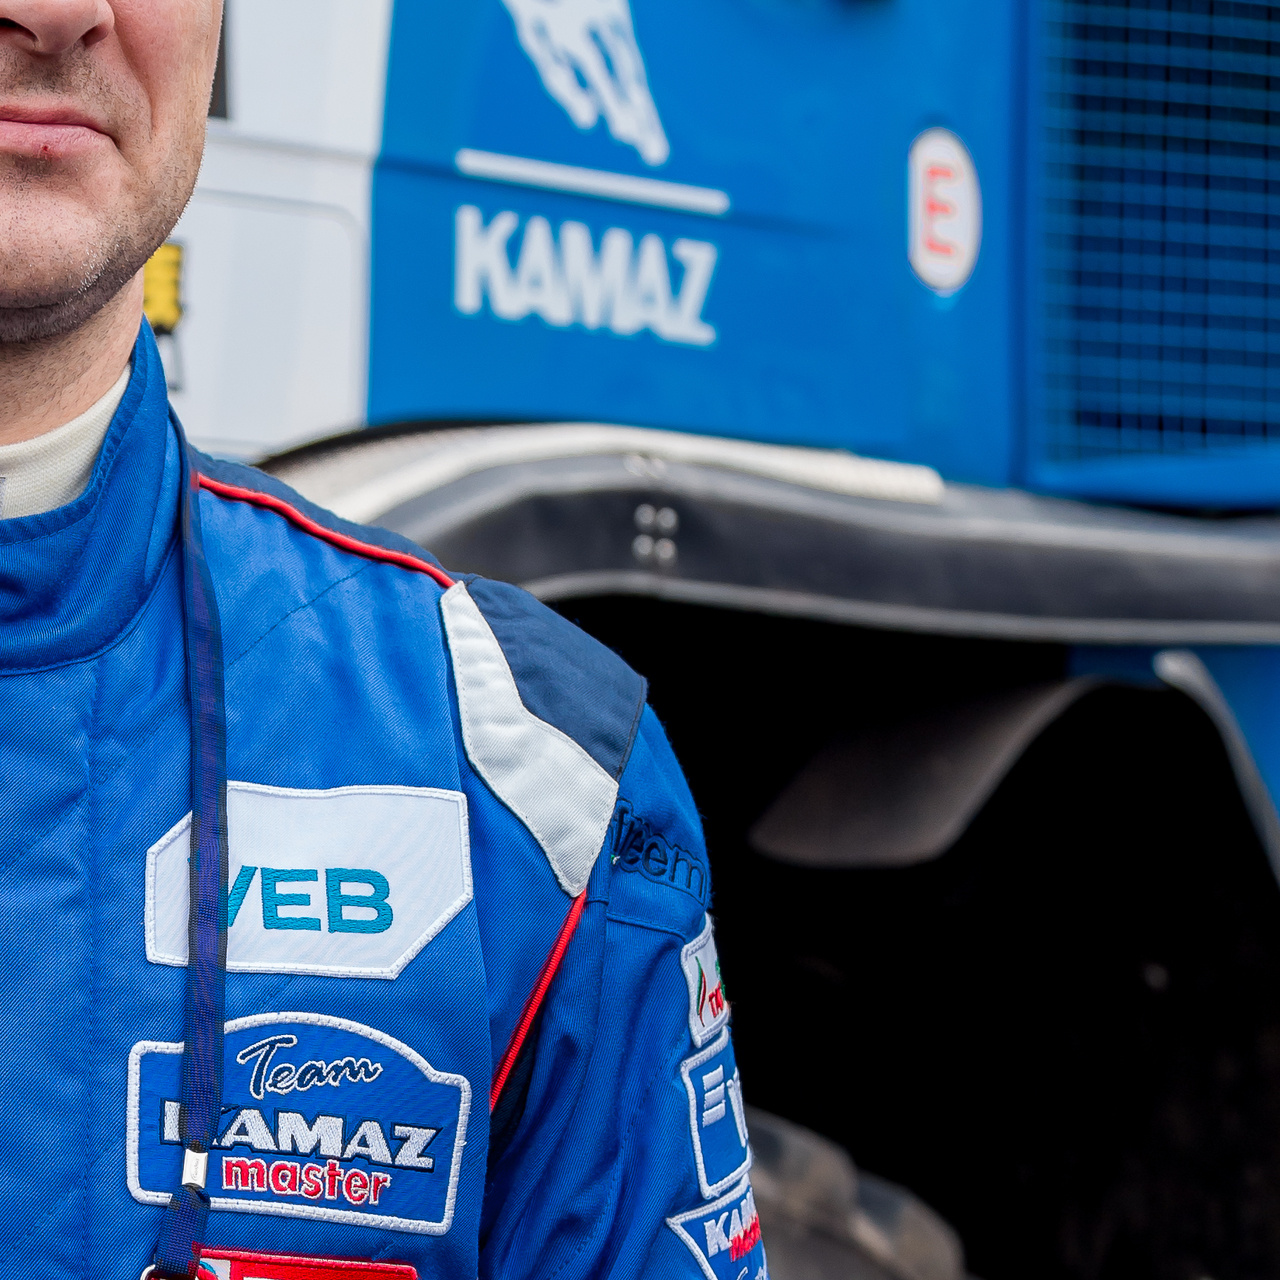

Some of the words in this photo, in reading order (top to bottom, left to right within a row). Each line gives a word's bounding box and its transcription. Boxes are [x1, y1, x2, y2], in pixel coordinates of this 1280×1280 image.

[455, 204, 718, 348] KAMAZ
[236, 1033, 383, 1100] Team
[220, 1154, 392, 1206] master
